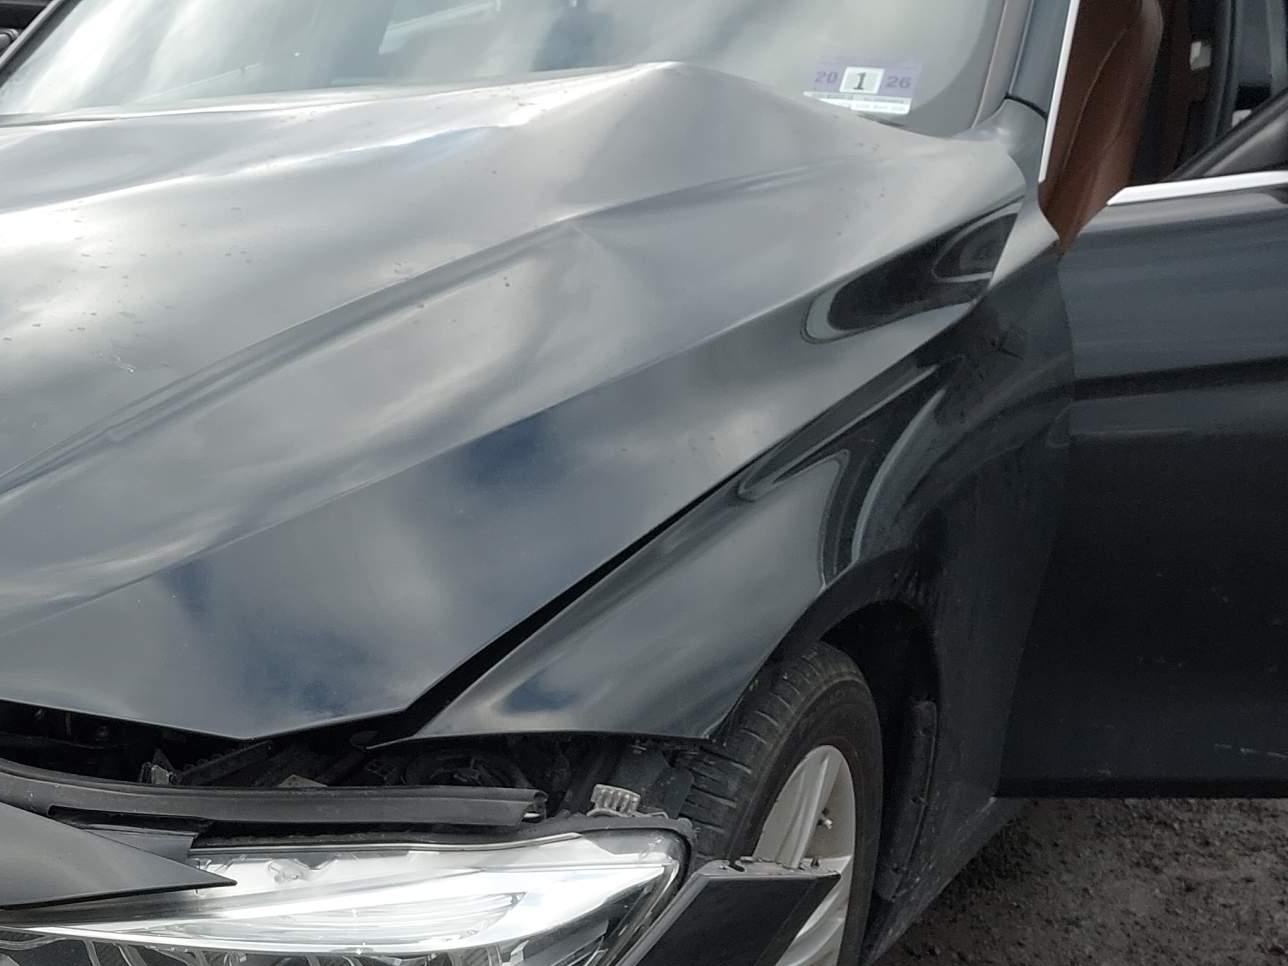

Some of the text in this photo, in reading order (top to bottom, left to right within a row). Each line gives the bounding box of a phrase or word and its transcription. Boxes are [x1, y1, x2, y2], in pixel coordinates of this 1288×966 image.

[814, 70, 911, 91] 20 1 26
